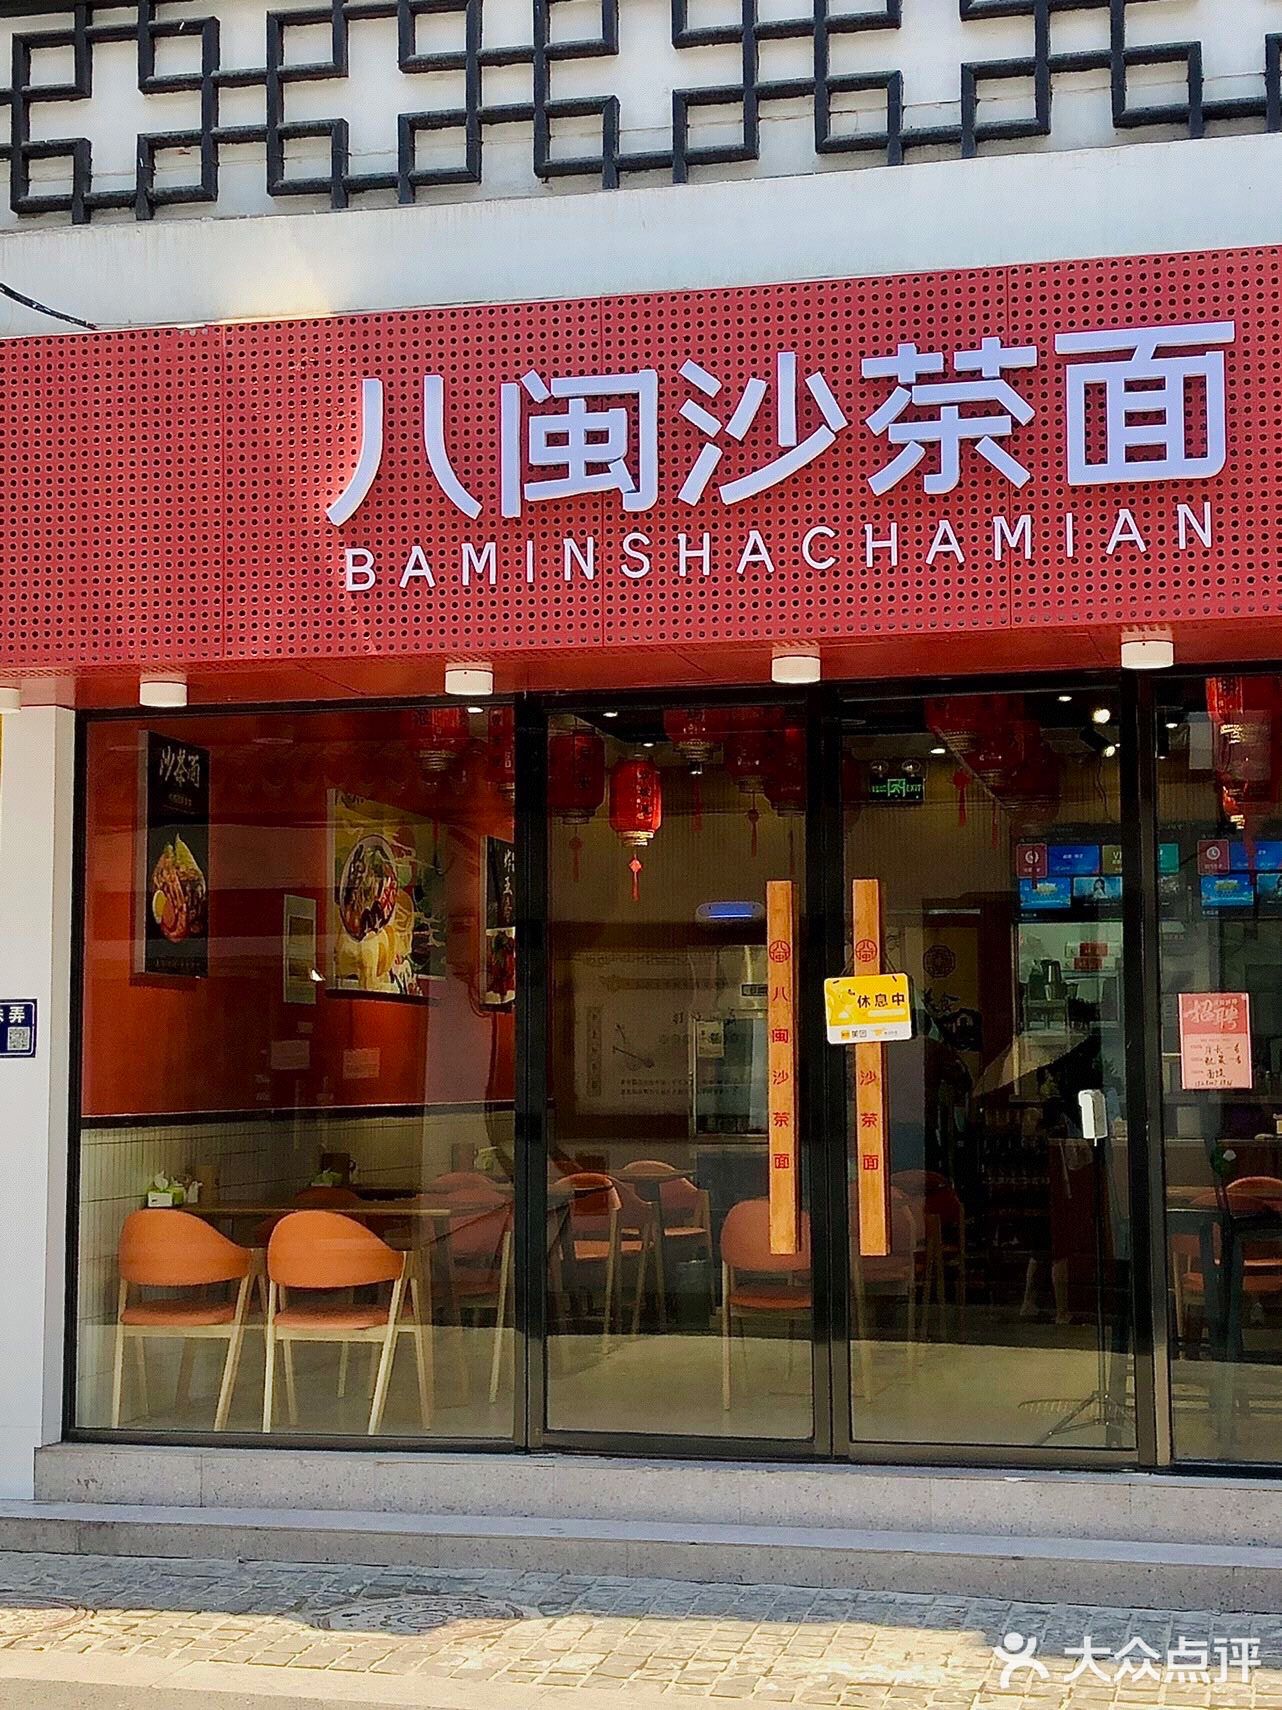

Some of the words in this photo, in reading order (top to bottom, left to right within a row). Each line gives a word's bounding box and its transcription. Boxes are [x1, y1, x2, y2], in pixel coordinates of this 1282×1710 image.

[327, 321, 1236, 527] 八闽沙茶面
[345, 502, 1214, 592] BAMINSHACHAMIAN
[906, 784, 922, 793] EXIT
[857, 992, 905, 1009] 休息中
[1183, 999, 1240, 1030] 招聘
[771, 986, 791, 1169] 八闽沙茶面
